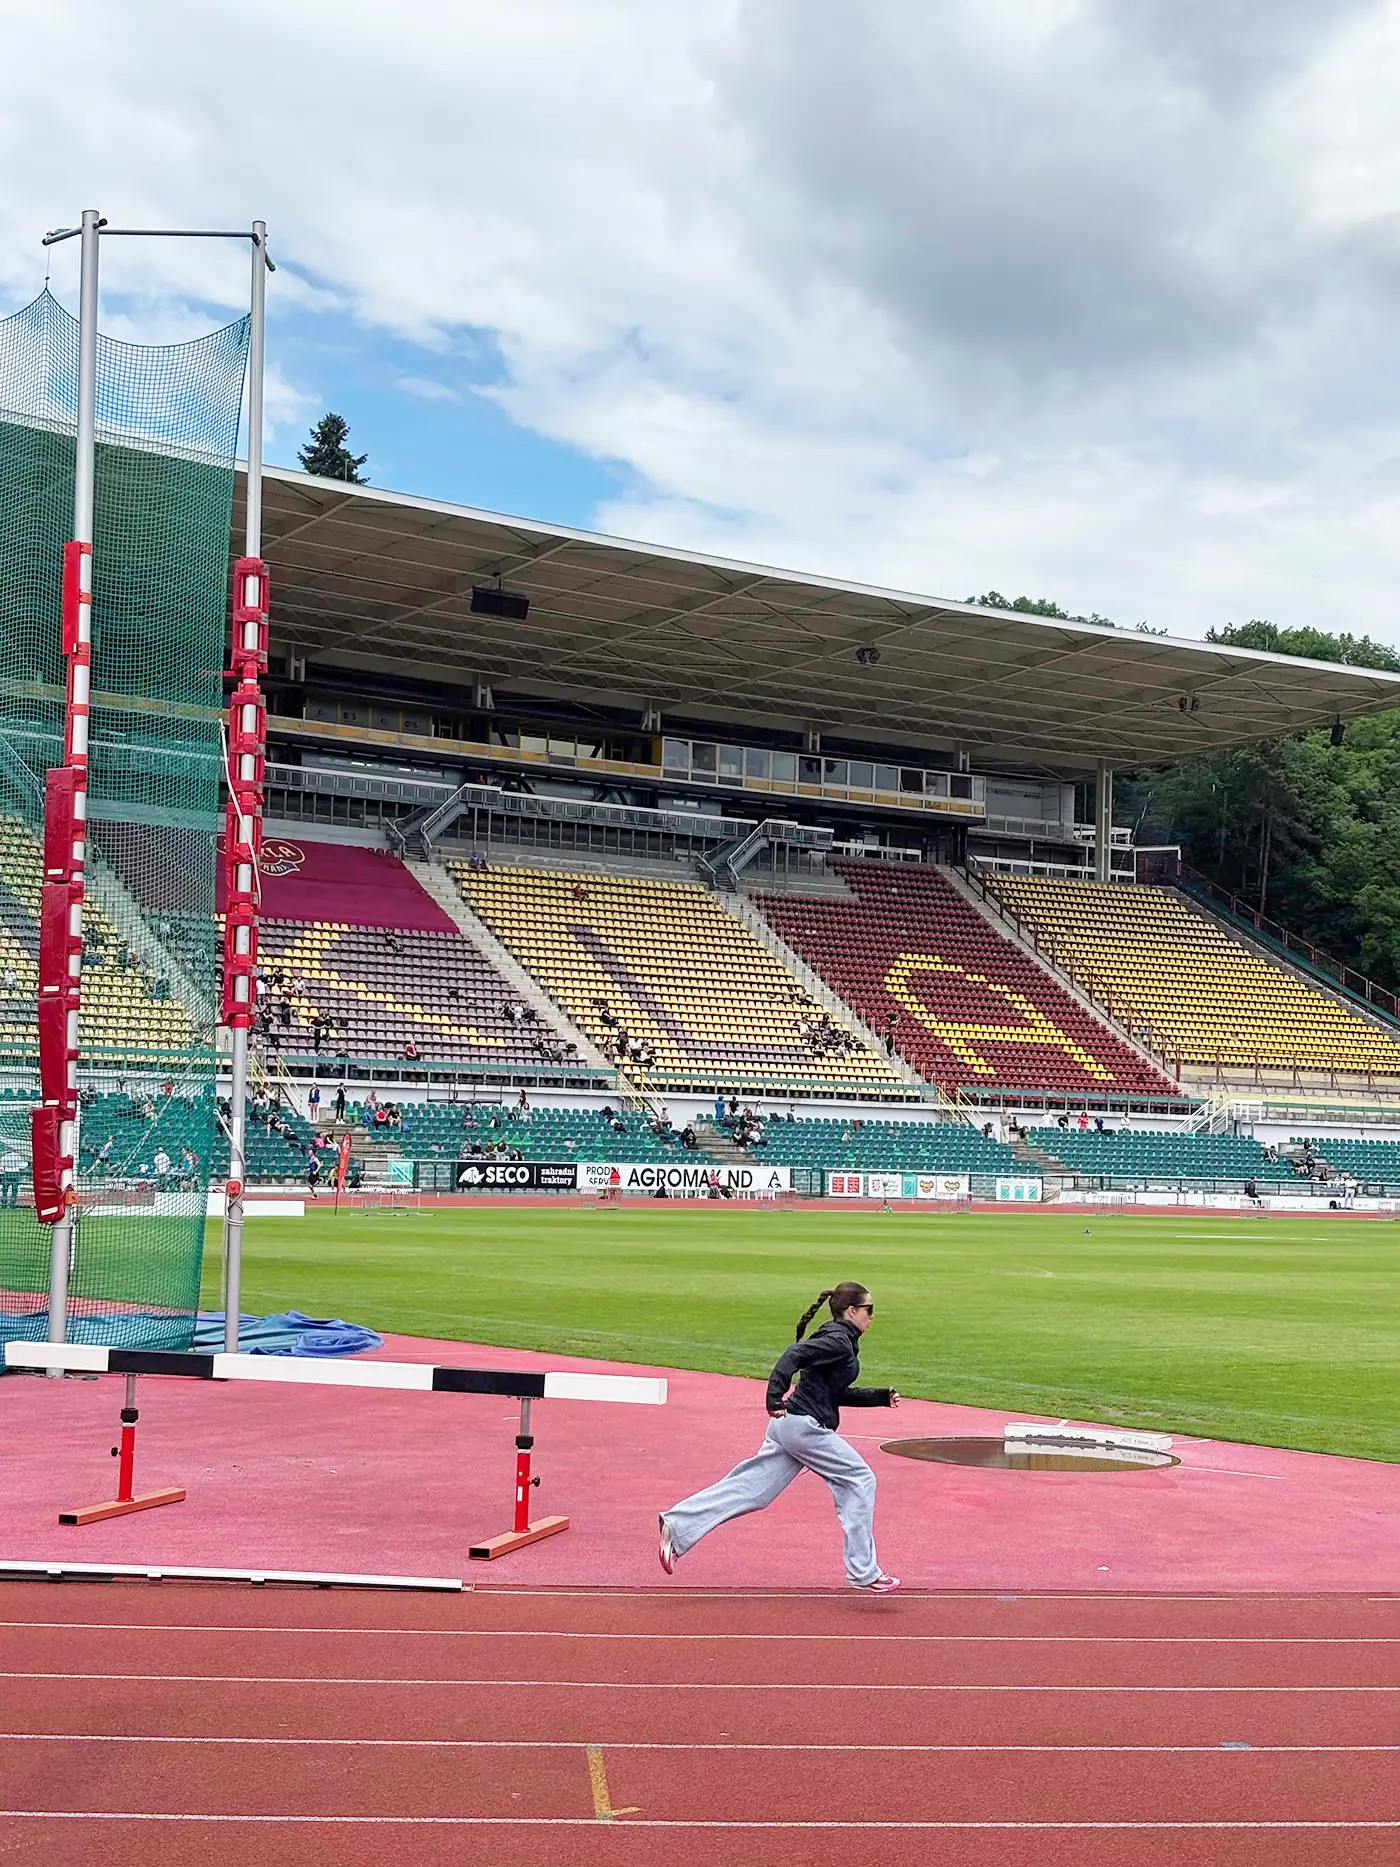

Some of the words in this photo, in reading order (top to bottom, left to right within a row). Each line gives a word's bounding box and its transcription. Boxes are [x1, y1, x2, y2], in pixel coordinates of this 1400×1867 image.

[485, 1165, 530, 1184] SECO
[540, 1166, 575, 1176] zahradní
[540, 1175, 573, 1186] traktory
